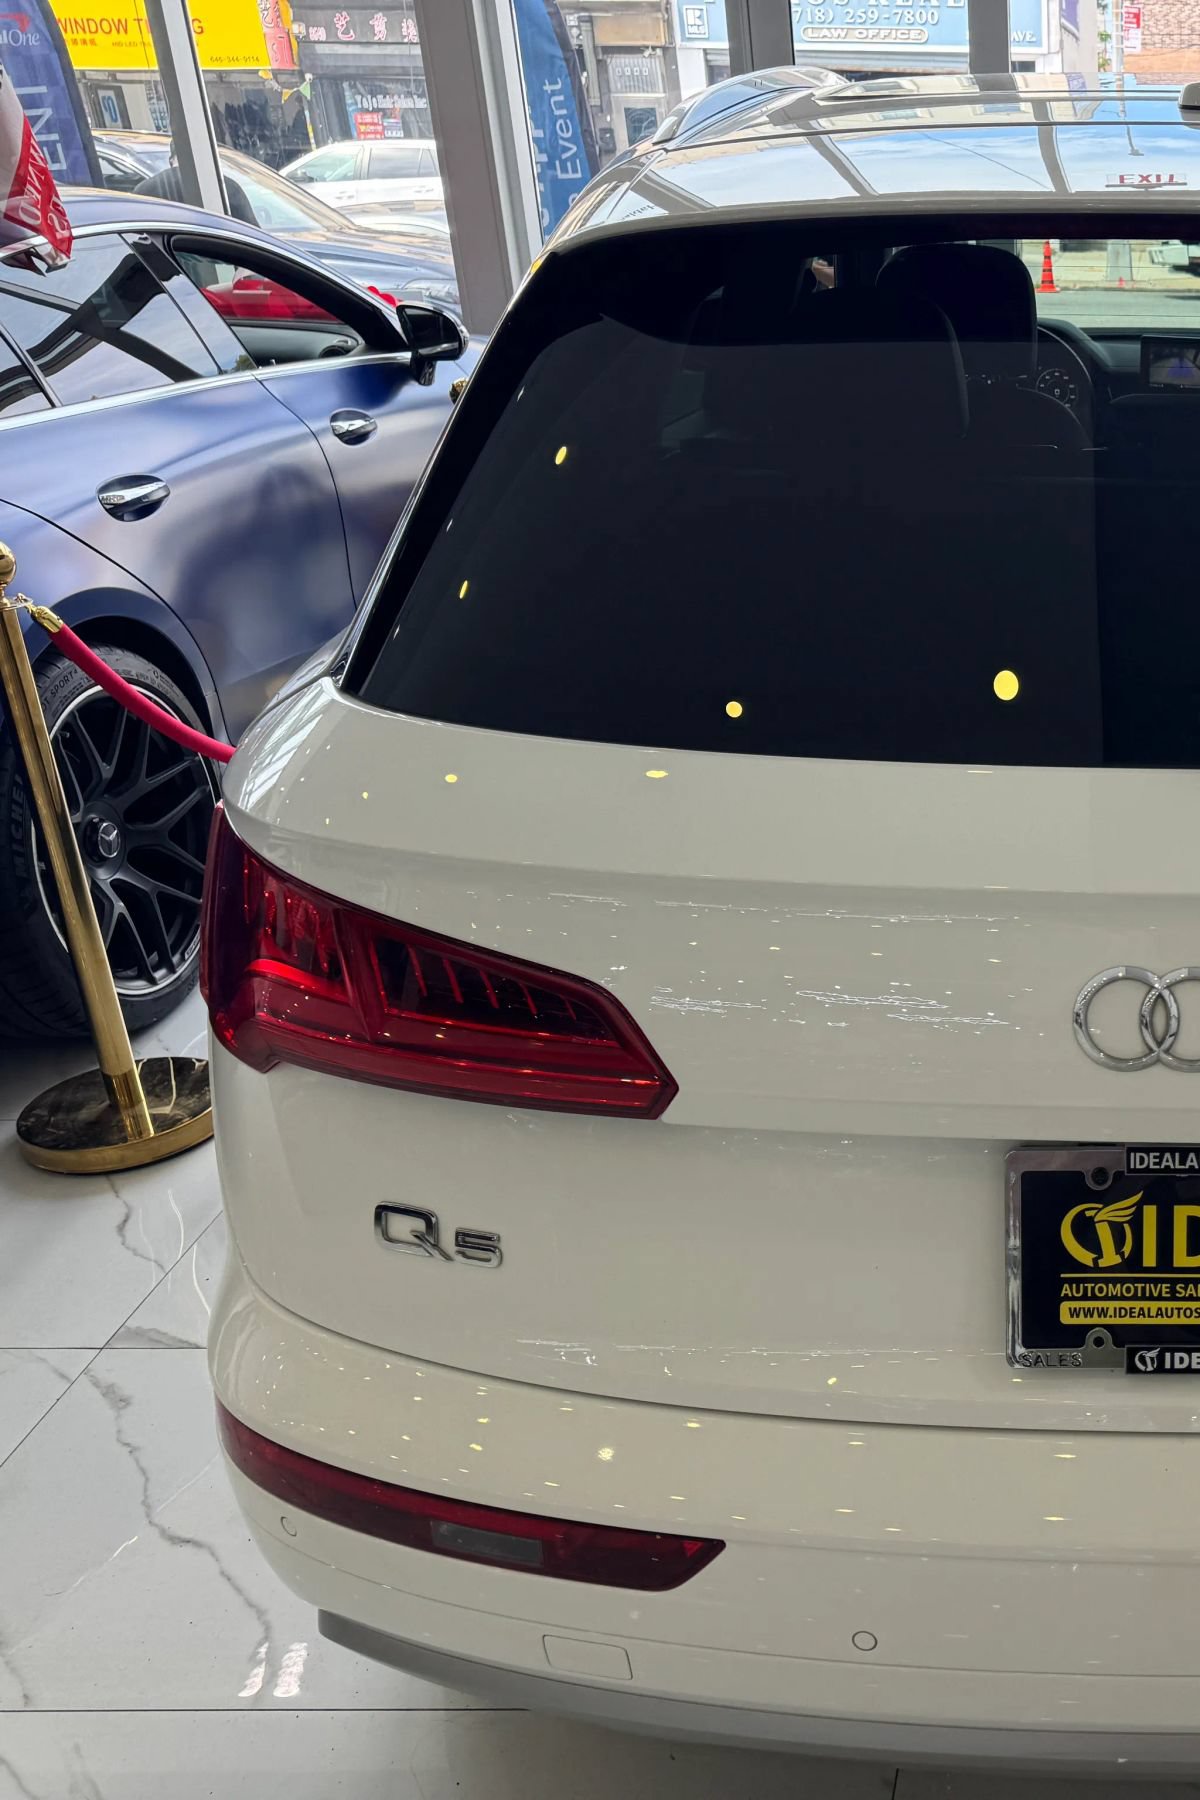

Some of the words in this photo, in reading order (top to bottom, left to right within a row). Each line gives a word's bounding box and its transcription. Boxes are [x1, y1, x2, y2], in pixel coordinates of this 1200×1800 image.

[844, 8, 939, 25] 259-7800
[807, 28, 848, 39] LAW
[856, 28, 922, 40] OFFICE
[543, 77, 582, 180] Event
[374, 1201, 503, 1268] Q5
[1060, 1283, 1171, 1298] AUTOMOTIVE
[1022, 1352, 1082, 1368] SALES
